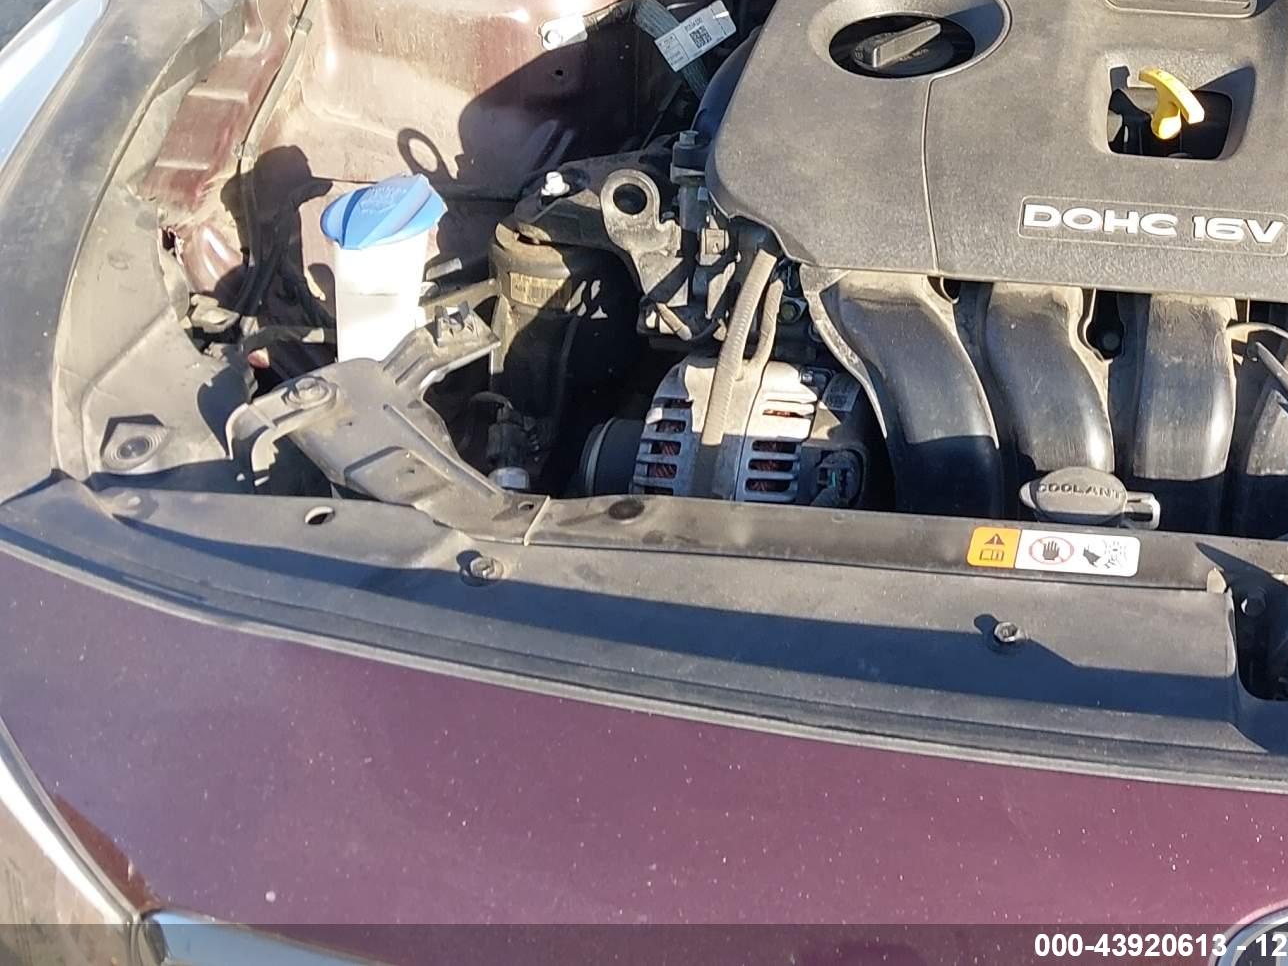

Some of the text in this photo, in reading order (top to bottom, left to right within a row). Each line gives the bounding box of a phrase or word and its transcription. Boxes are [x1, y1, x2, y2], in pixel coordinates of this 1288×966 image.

[1022, 203, 1285, 244] DOHC 16V
[1038, 482, 1123, 499] COOLANT
